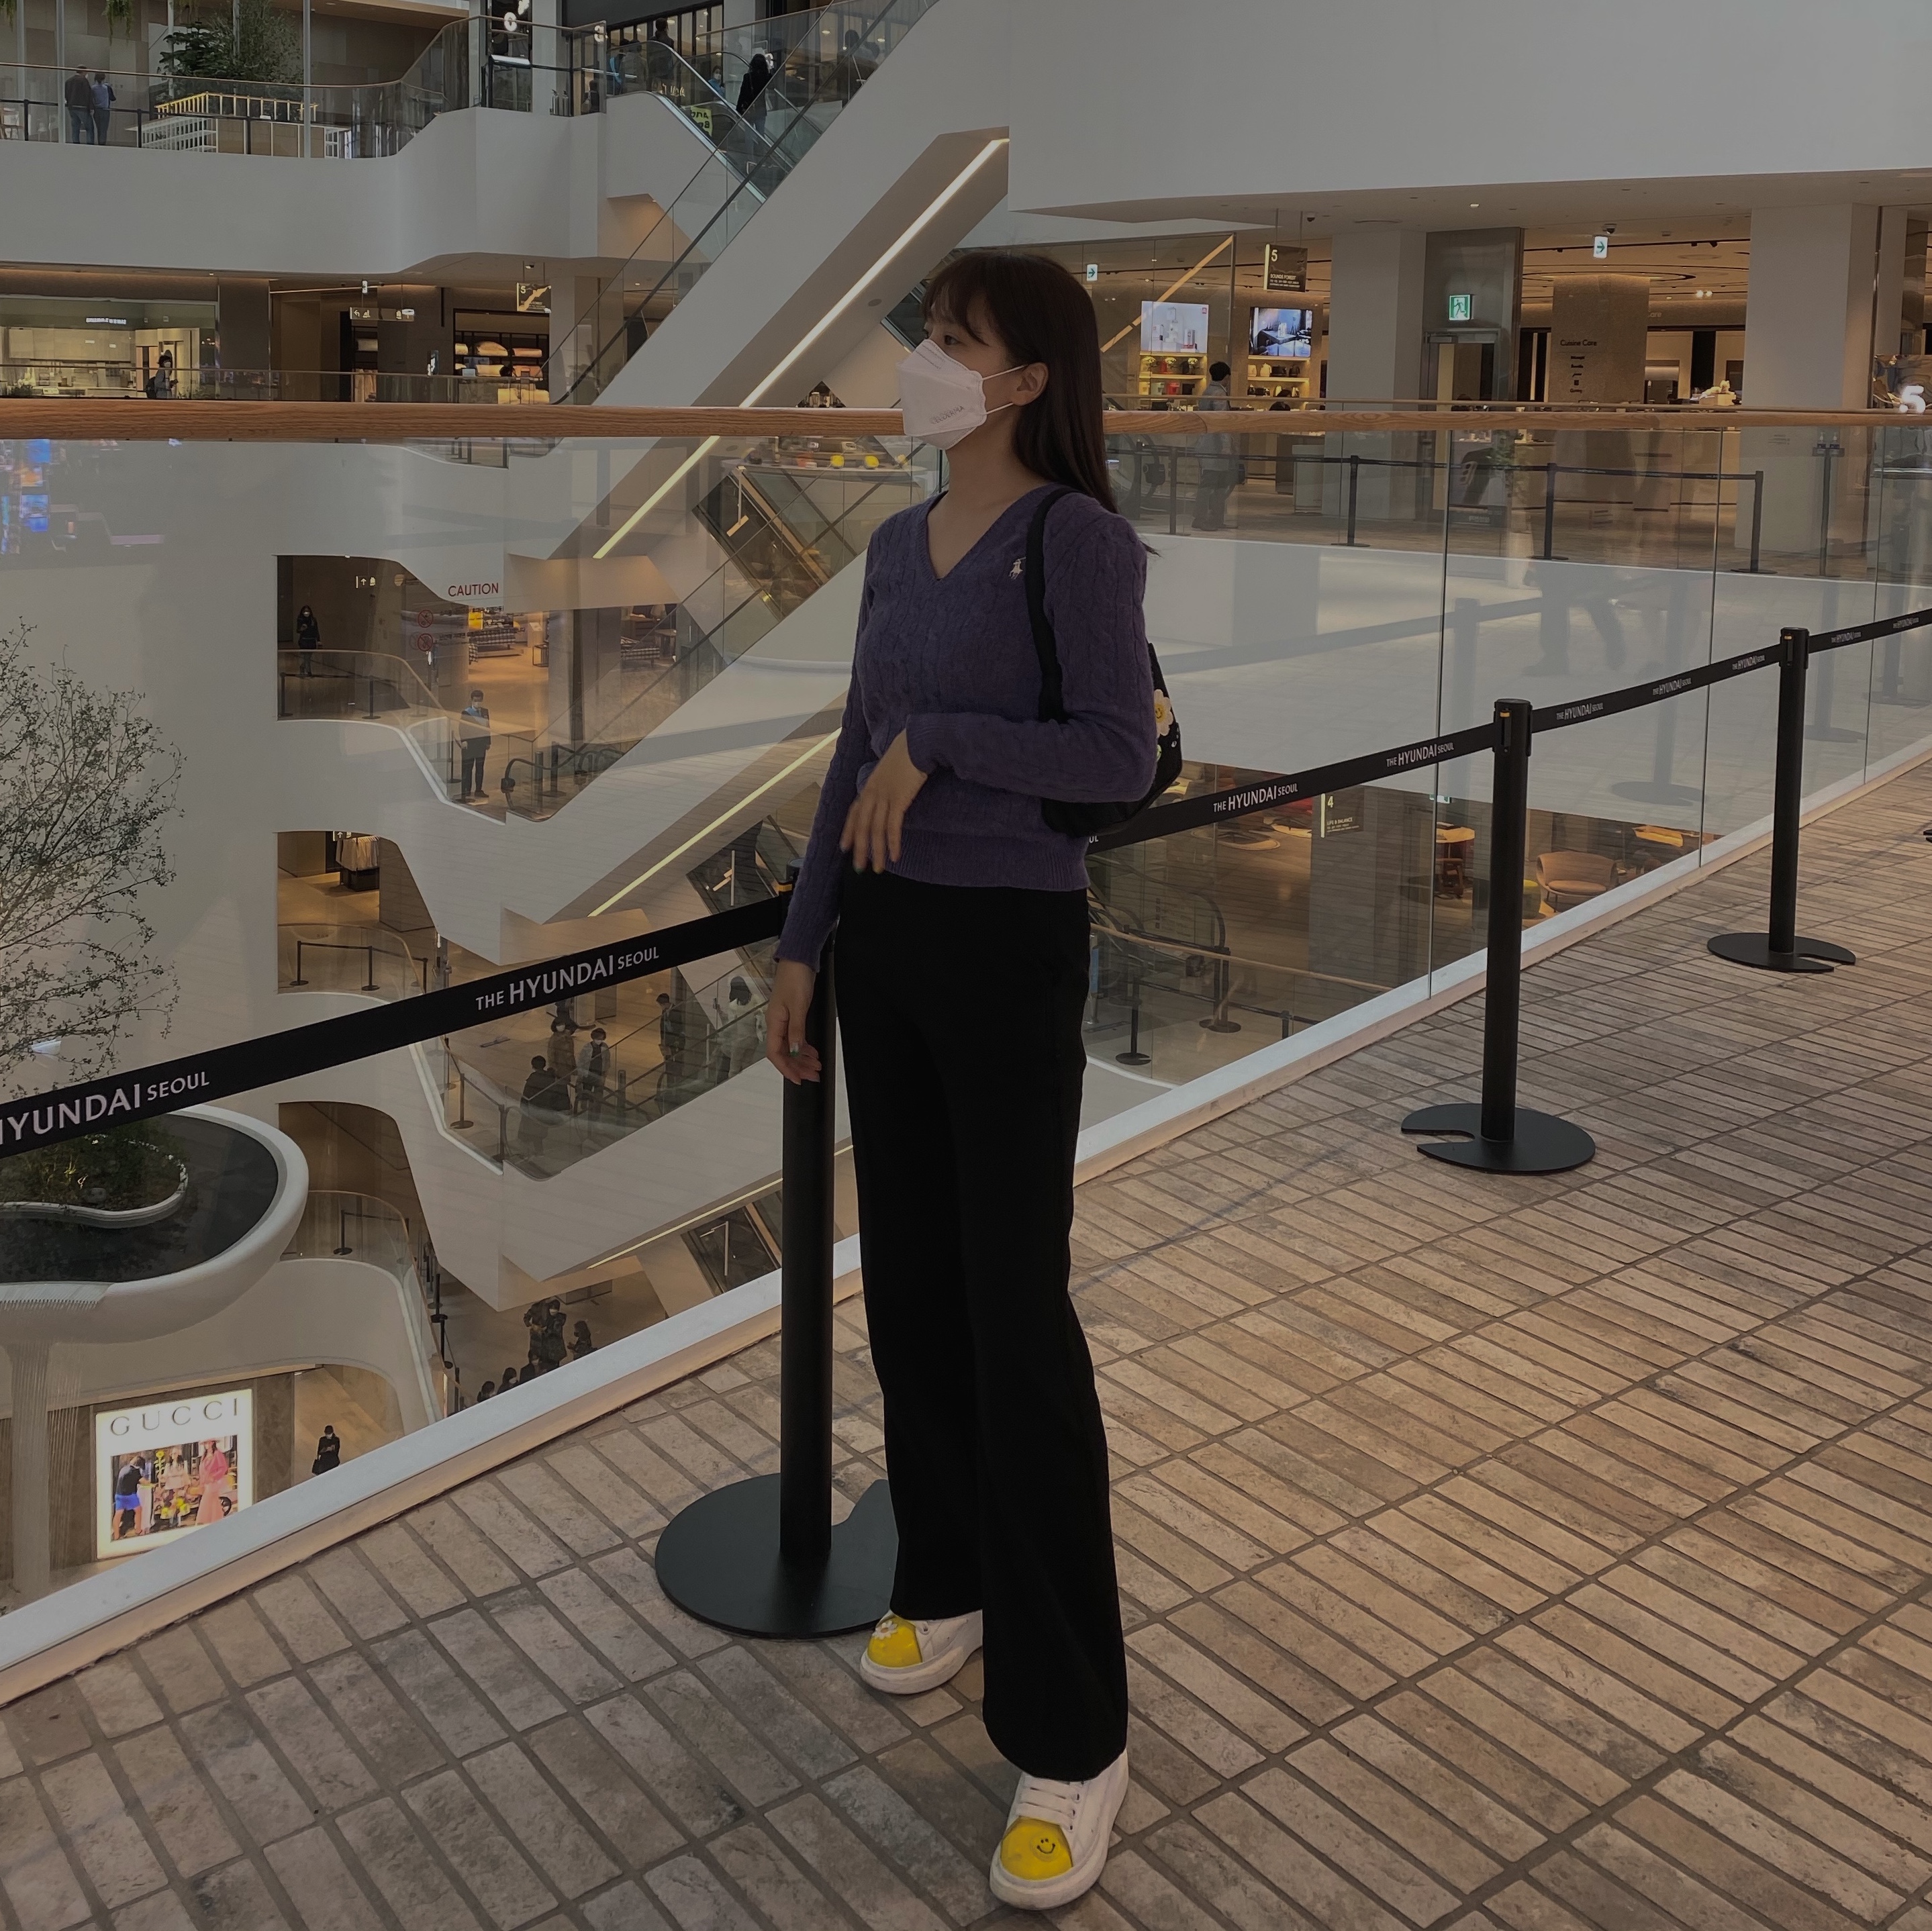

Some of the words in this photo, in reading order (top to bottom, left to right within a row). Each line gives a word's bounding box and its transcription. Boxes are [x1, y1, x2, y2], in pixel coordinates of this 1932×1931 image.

[1271, 249, 1278, 262] 5
[520, 285, 526, 294] 5
[1899, 385, 1926, 414] 5
[448, 582, 499, 597] CAUTION
[1659, 679, 1682, 695] HYUNDAI
[1564, 703, 1592, 720] HYUNDAI
[1386, 756, 1397, 767] THE
[1398, 744, 1437, 766] HYUNDAI
[1437, 742, 1454, 754] SEOUL
[1213, 801, 1227, 813] THE
[1228, 785, 1277, 811] HYUNDAI
[1277, 783, 1298, 797] SEOUL
[1327, 795, 1334, 808] 4
[475, 990, 504, 1010] THE
[510, 954, 614, 1004] HYUNDAI
[618, 946, 659, 970] SEOUL
[147, 1071, 210, 1101] SEOUL
[111, 1398, 238, 1436] GUCCI
